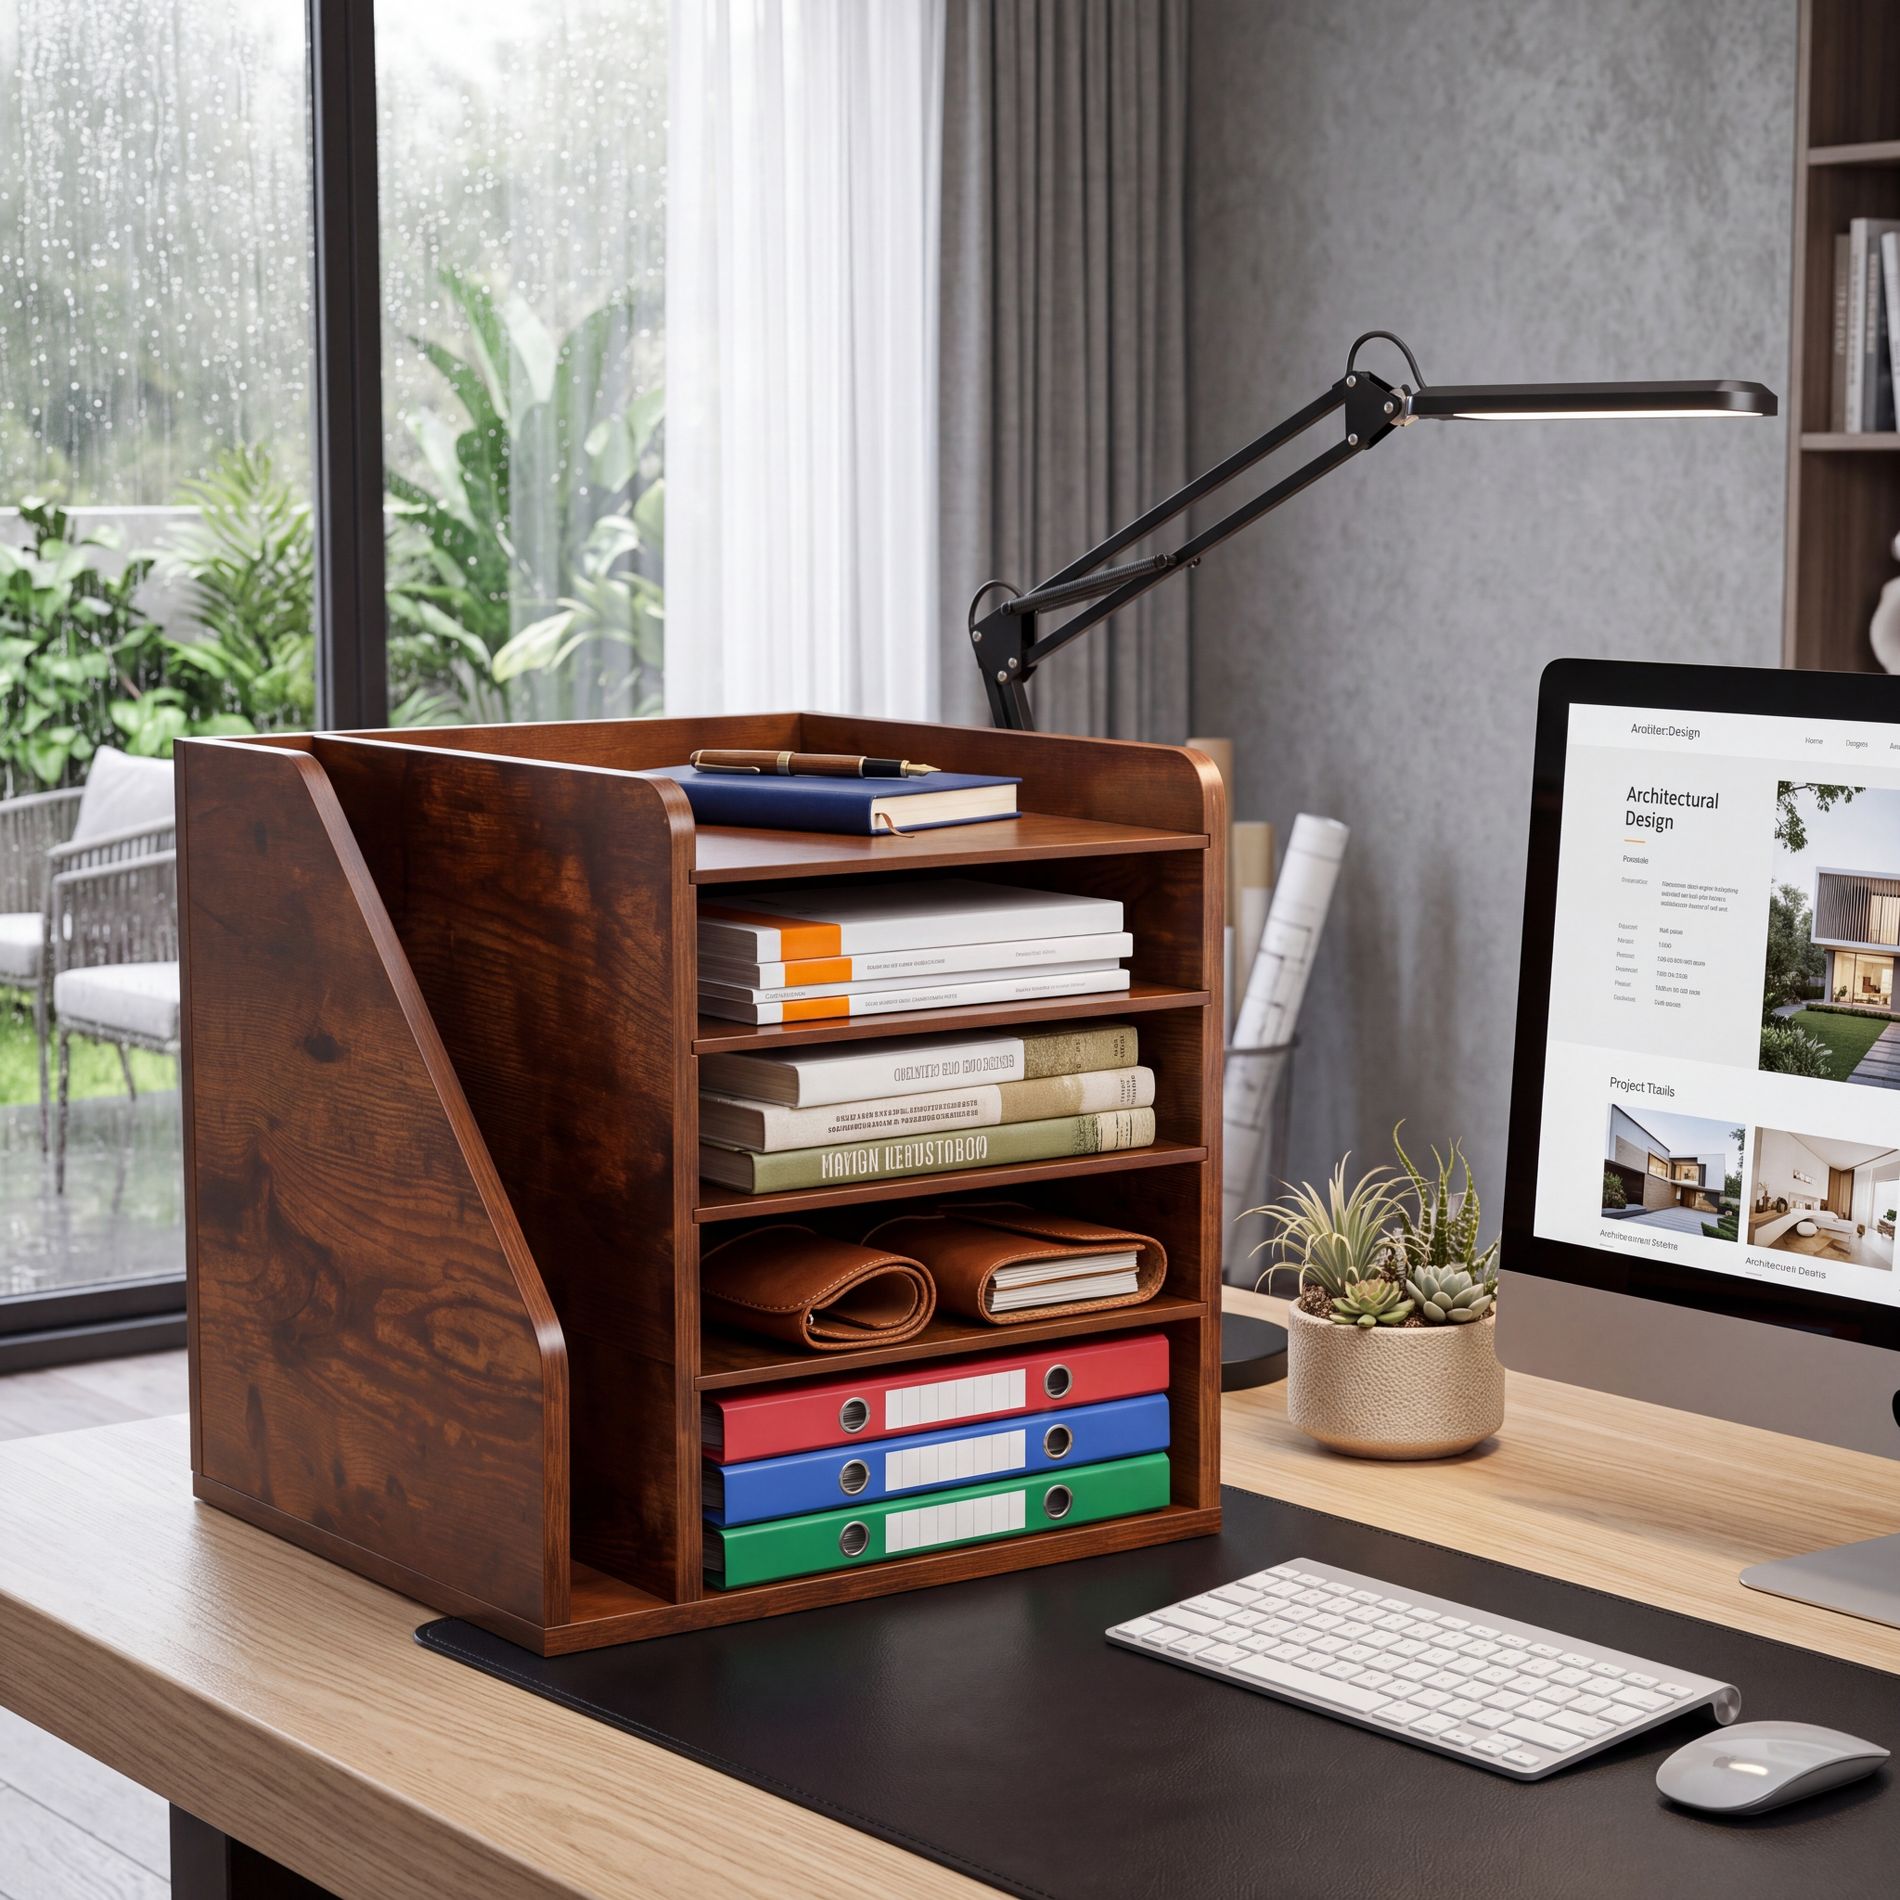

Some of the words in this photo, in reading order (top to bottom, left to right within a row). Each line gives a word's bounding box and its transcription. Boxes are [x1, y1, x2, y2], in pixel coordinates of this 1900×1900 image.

[1626, 786, 1719, 809] Architectural
[1625, 810, 1674, 833] Design
[1609, 1076, 1645, 1093] Project
